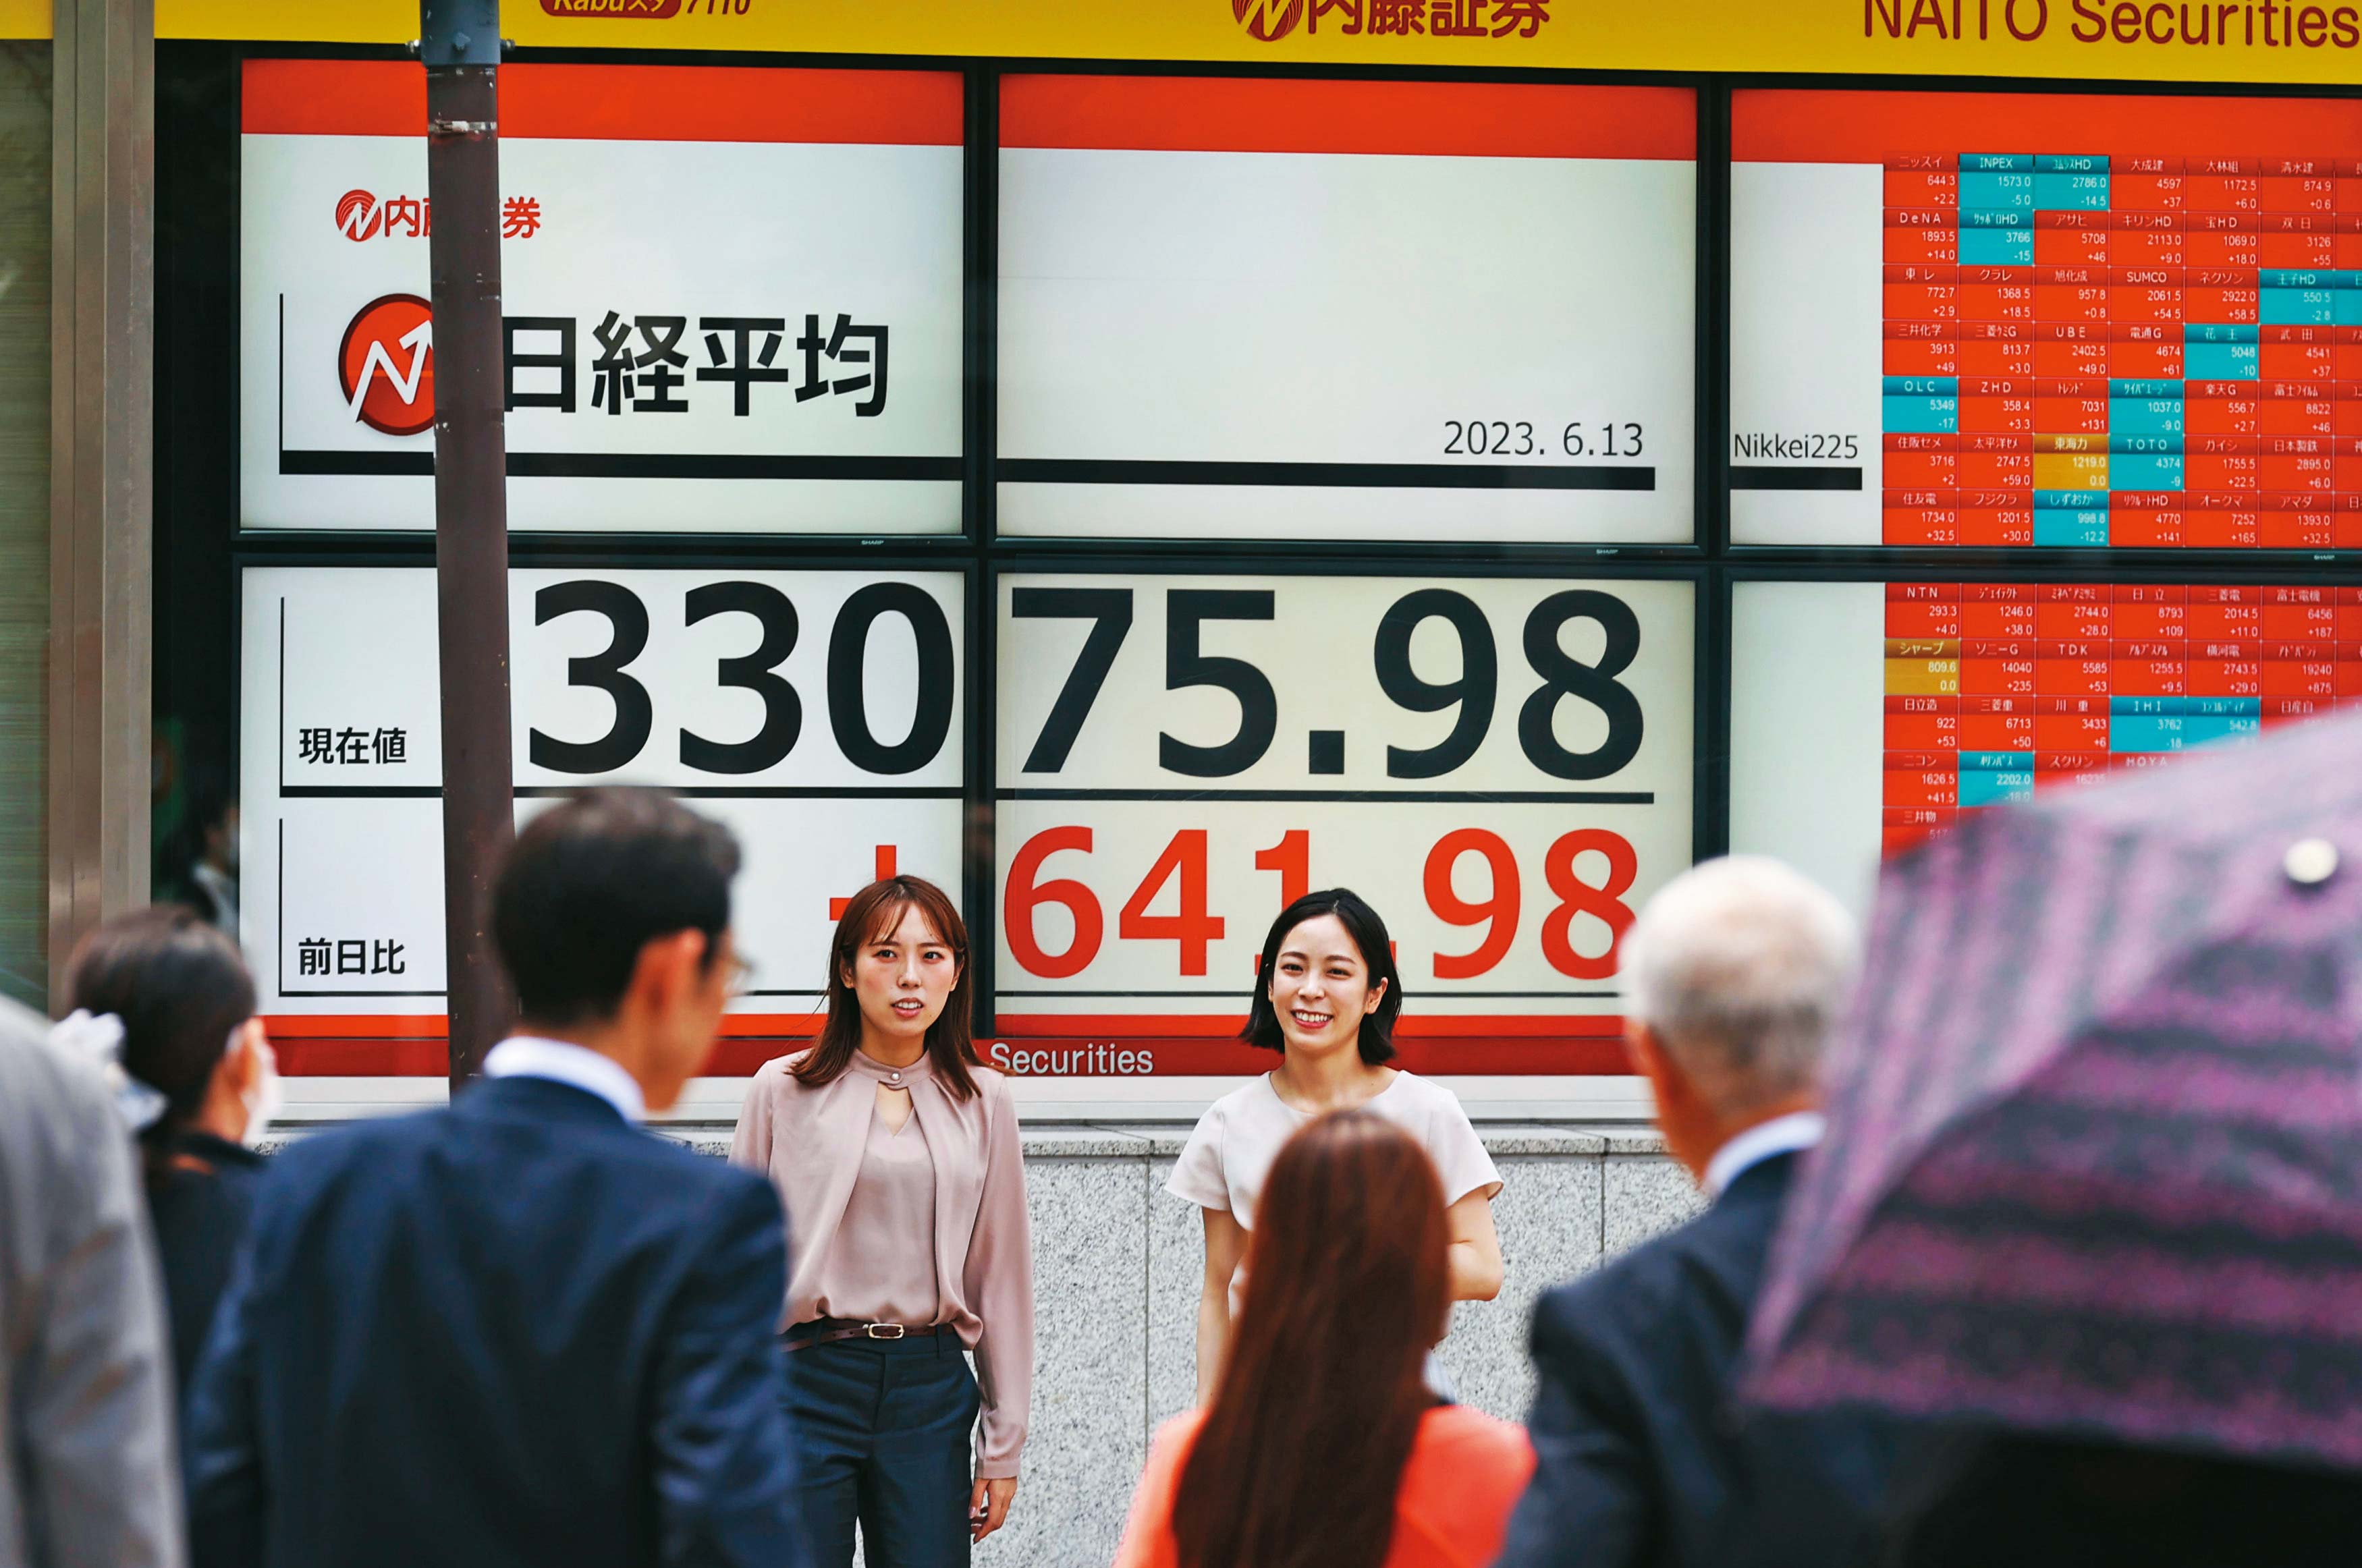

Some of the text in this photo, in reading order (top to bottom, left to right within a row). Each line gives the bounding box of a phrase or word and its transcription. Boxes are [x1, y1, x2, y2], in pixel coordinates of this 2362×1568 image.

[1864, 0, 2360, 49] NAITO Securities
[1979, 157, 2013, 169] INPEX
[2131, 159, 2164, 171] 大成建
[1927, 174, 1956, 186] 644.3
[2072, 177, 2107, 188] 2786.0
[2156, 177, 2182, 190] 4597
[1933, 193, 1956, 205] +2.2
[2162, 196, 2182, 208] +37
[385, 194, 541, 238] 内券
[1900, 212, 1941, 224] DeNA
[2122, 215, 2172, 227] キリンHD
[1922, 230, 1956, 242] 1893.5
[2081, 232, 2106, 245] 5708
[2147, 233, 2182, 246] 2113.0
[1927, 249, 1956, 260] +14.0
[2087, 251, 2106, 262] +46
[1979, 269, 2012, 281] クラレ
[2126, 271, 2167, 283] SUMCO
[1927, 286, 1955, 299] 772.7
[2147, 289, 2181, 302] 2061.5
[1933, 305, 1955, 317] +2.9
[2002, 306, 2031, 318] +18.5
[2084, 307, 2106, 319] +0.8
[1898, 323, 1942, 337] 三井化学
[2056, 326, 2085, 338] UBE
[1930, 343, 1955, 355] 3913
[2002, 343, 2031, 356] 813.7
[2155, 345, 2181, 357] 4674
[502, 309, 889, 418] 日経平均
[1936, 361, 1955, 373] +49
[2008, 362, 2031, 374] +3.0
[2079, 363, 2106, 374] +49.0
[2162, 364, 2180, 375] +61
[1904, 380, 1935, 393] OLC
[1981, 381, 2012, 393] ZHD
[2003, 399, 2031, 412] 358.4
[2081, 400, 2105, 412] 7031
[2148, 401, 2181, 414] 1037.0
[2008, 418, 2031, 430] +3.3
[2081, 418, 2105, 430] +131
[1563, 422, 1643, 457] 6.13
[2126, 438, 2168, 451] TOTO
[1734, 433, 1859, 459] Nikkei225
[1930, 455, 1955, 467] 3716
[2155, 457, 2181, 469] 4374
[1942, 473, 1955, 486] +2
[2002, 474, 2031, 486] +59.0
[2089, 474, 2108, 487] 0.0
[1903, 492, 1937, 505] 住友電
[1921, 511, 1955, 524] 1734.0
[2155, 512, 2181, 525] 4770
[1926, 529, 1955, 542] +32.5
[2002, 530, 2031, 542] +30.0
[2156, 532, 2180, 542] +141
[1906, 586, 1938, 598] NTN
[1929, 605, 1958, 617] 293.3
[2158, 606, 2184, 619] 8793
[1935, 623, 1958, 635] +4.0
[2004, 623, 2033, 636] +38.0
[2080, 624, 2109, 636] +28.0
[2158, 625, 2184, 637] +109
[2058, 643, 2087, 656] TDK
[2002, 661, 2033, 673] 14040
[2082, 662, 2108, 674] 5585
[2149, 662, 2183, 675] 1255.5
[1940, 679, 1958, 692] 0.0
[2007, 680, 2032, 692] +235
[2088, 680, 2108, 692] +53
[2161, 681, 2183, 693] +9.5
[1904, 698, 1938, 711] 日立造
[1936, 717, 1956, 729] 922
[2006, 717, 2032, 729] 6713
[2082, 718, 2107, 730] 3433
[298, 726, 407, 765] 現在値
[1936, 735, 1956, 748] +53
[2012, 735, 2032, 748] +50
[2093, 736, 2107, 748] +6
[1922, 773, 1956, 785] 1626.5
[1927, 792, 1955, 803] +41.5
[298, 936, 406, 976] 前日比
[989, 1042, 1154, 1075] Securities
